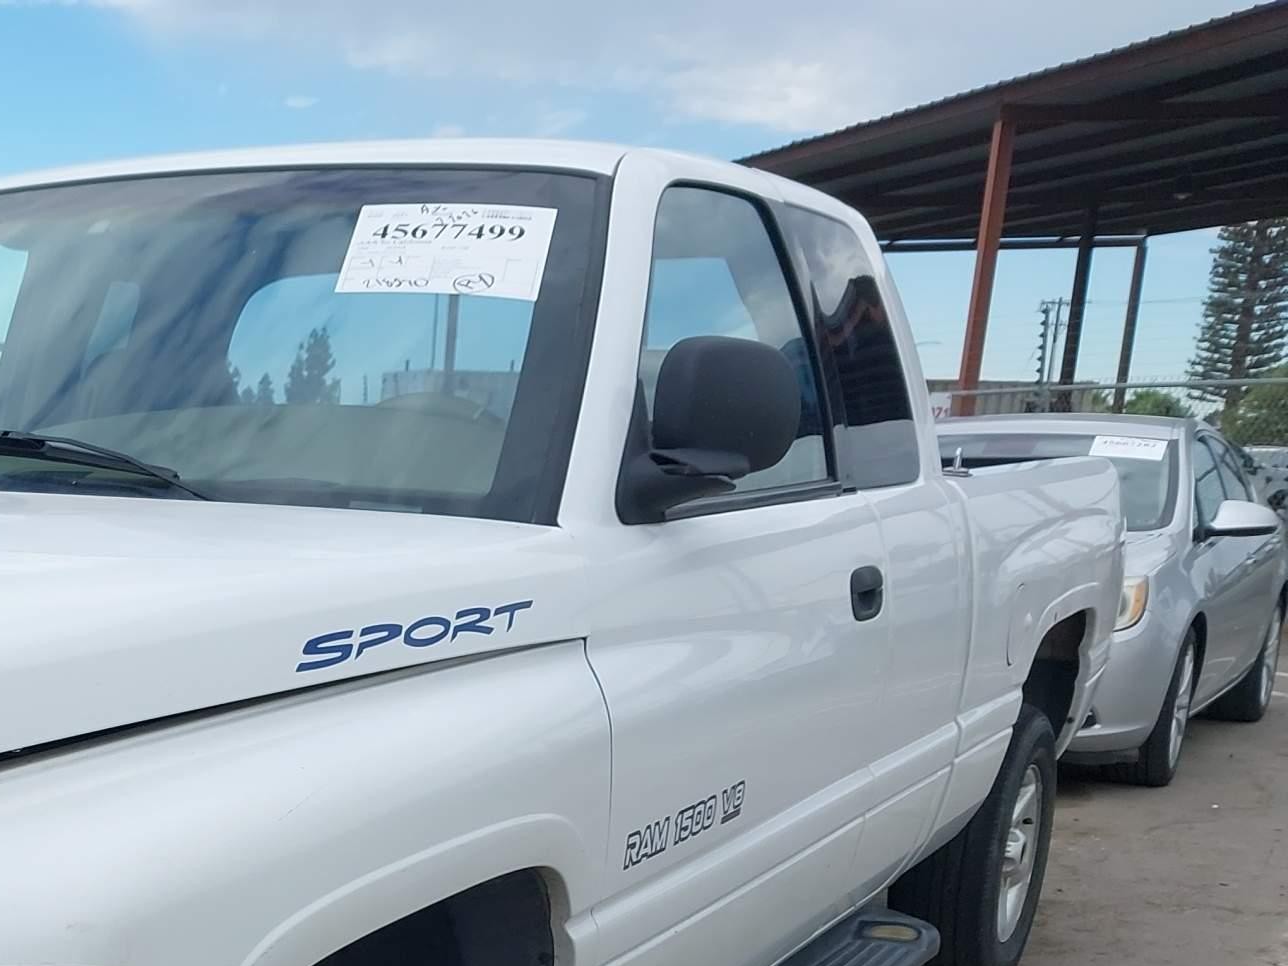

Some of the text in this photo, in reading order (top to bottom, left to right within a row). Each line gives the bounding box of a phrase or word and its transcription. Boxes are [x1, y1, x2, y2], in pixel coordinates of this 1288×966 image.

[372, 223, 526, 241] 45677499
[295, 599, 534, 673] SPORT
[623, 779, 746, 871] RAM 1500 V8
